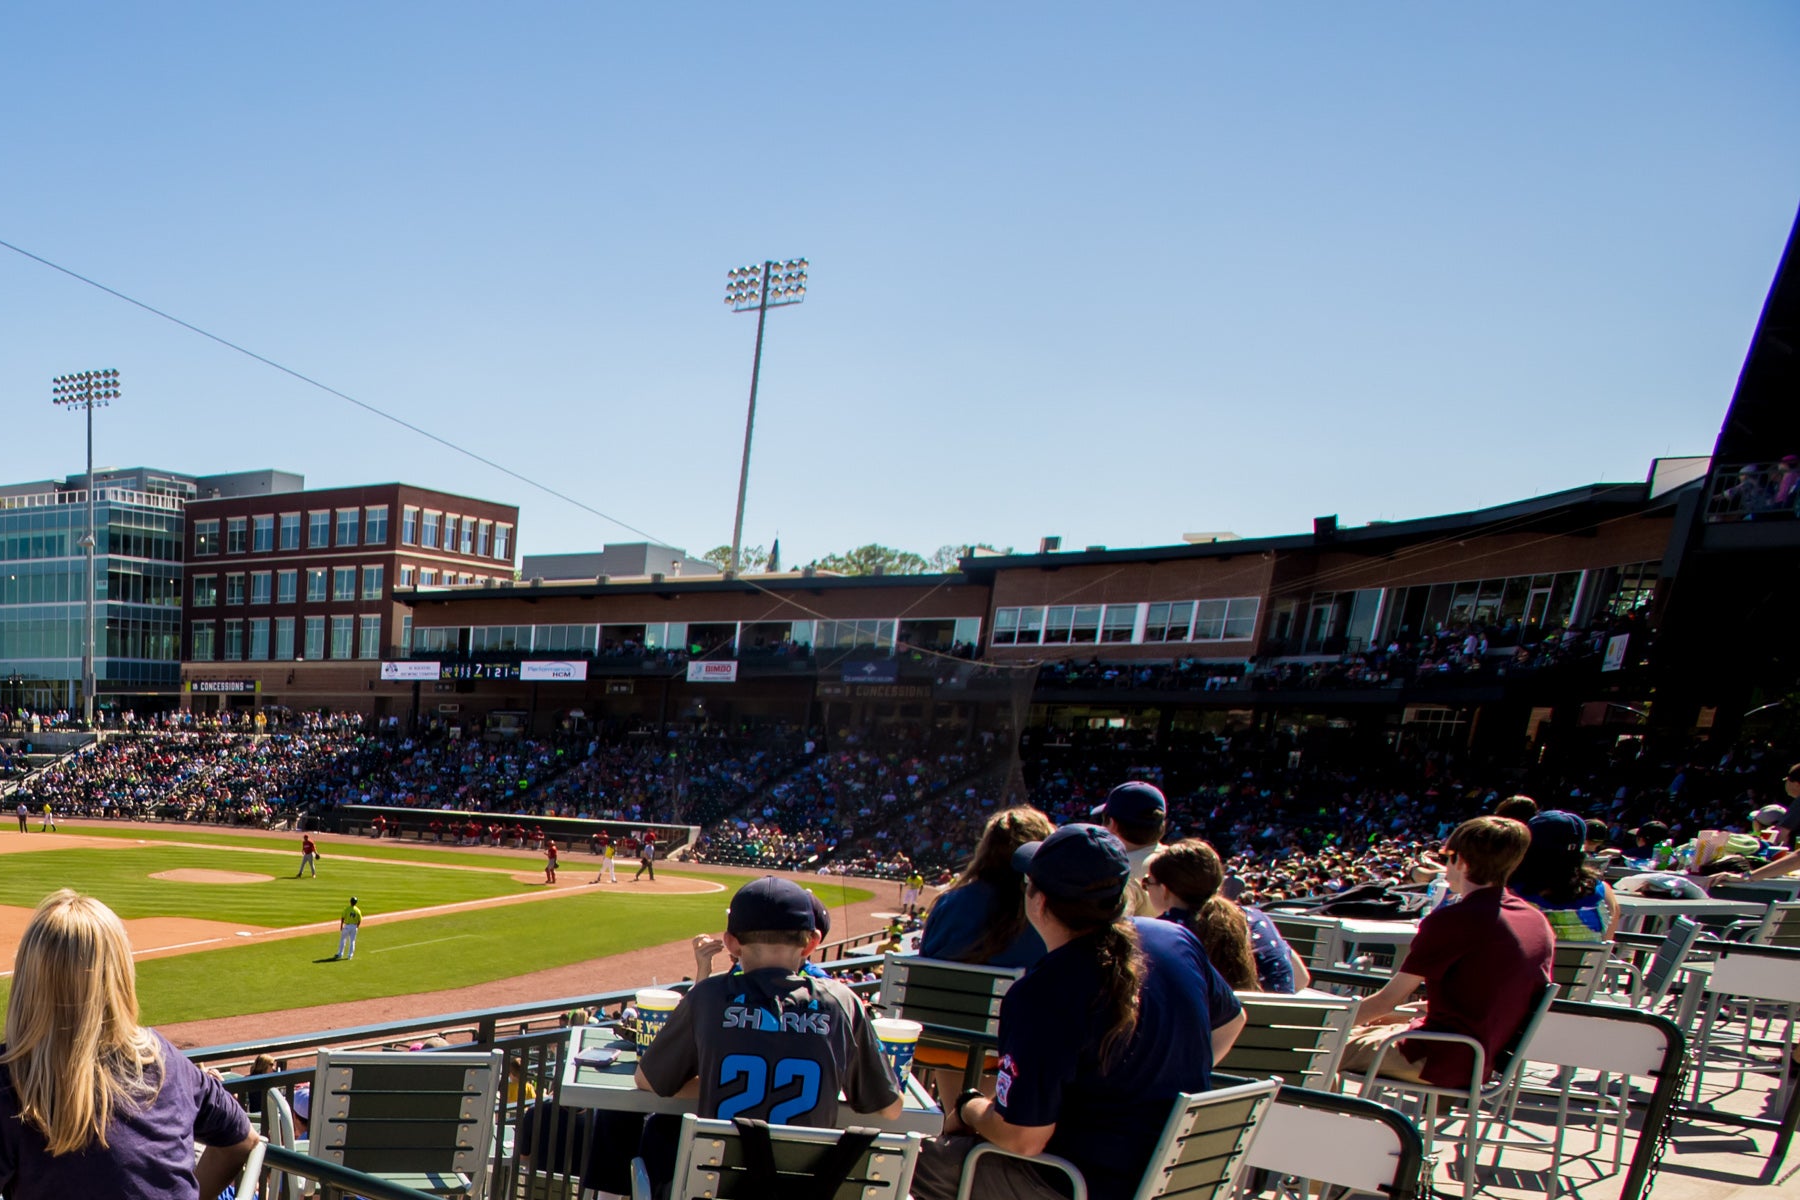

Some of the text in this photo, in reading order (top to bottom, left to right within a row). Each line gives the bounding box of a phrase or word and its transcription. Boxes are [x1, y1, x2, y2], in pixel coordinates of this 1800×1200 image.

[475, 663, 482, 674] 7
[486, 668, 490, 677] 1
[494, 668, 501, 677] 2
[504, 668, 508, 677] 1
[200, 681, 244, 691] CONCESSIONS
[856, 685, 931, 697] CONCESSIONS
[722, 1005, 831, 1035] SHARKS
[717, 1053, 822, 1126] 22
